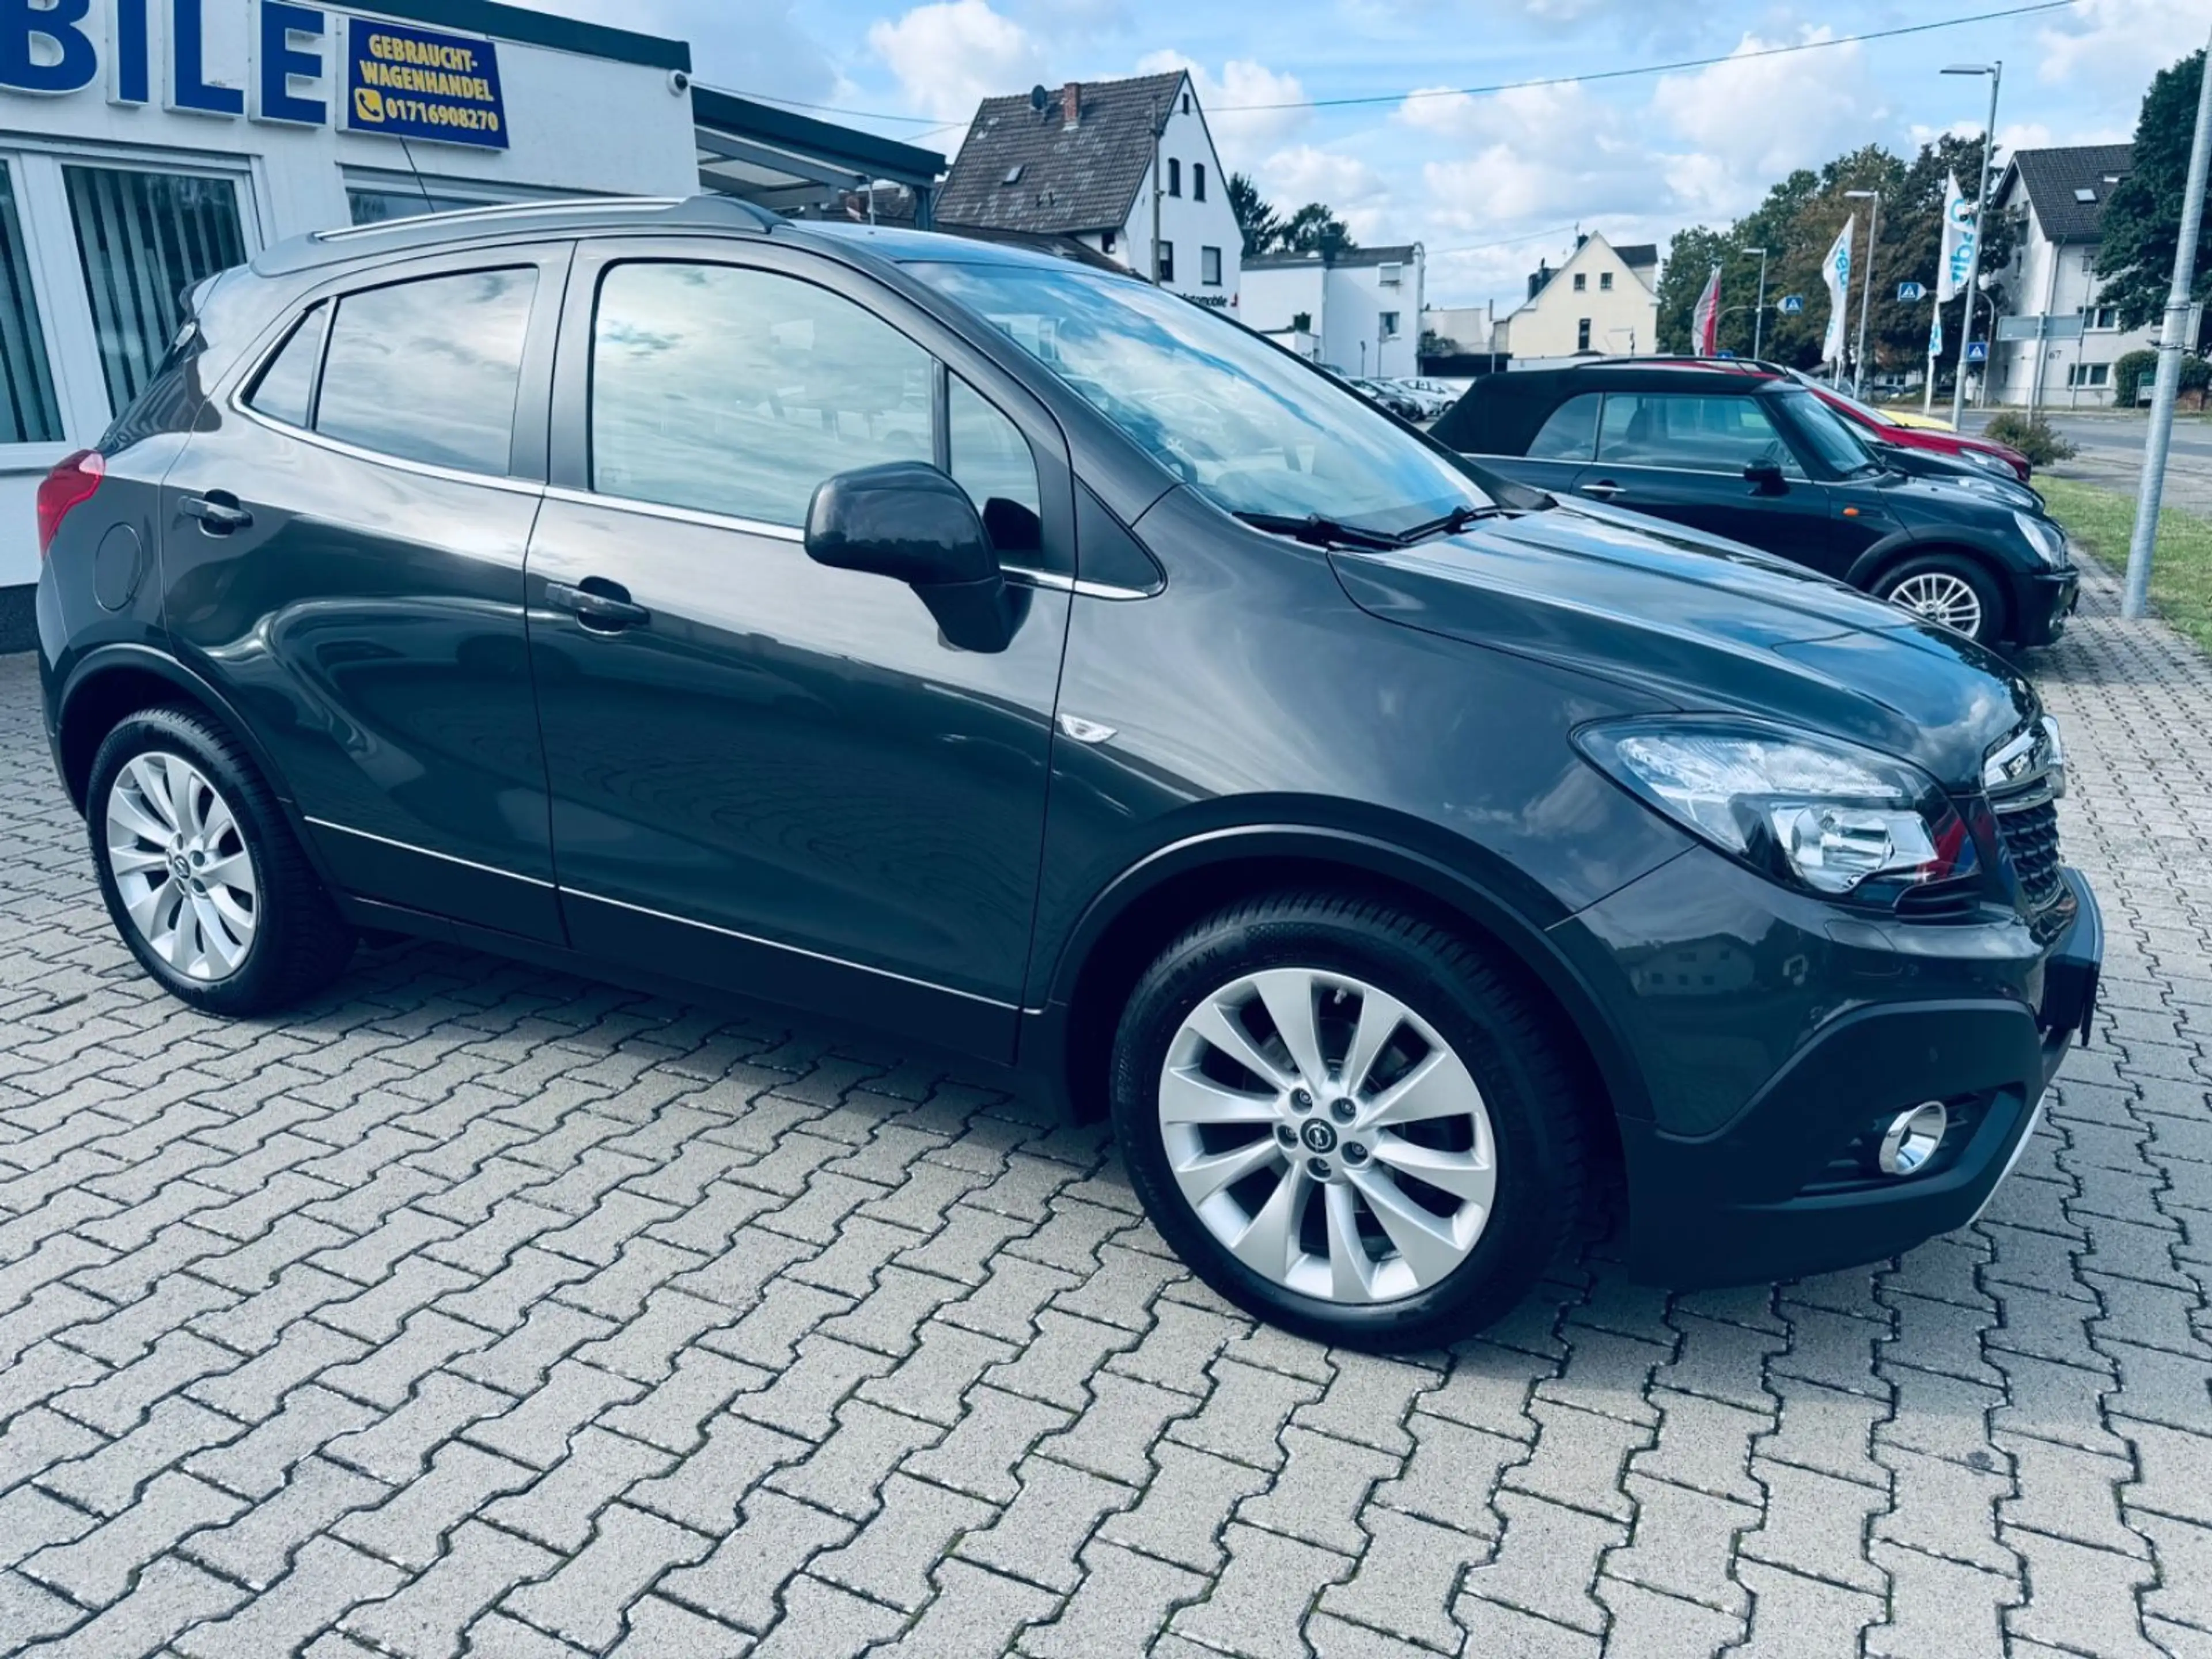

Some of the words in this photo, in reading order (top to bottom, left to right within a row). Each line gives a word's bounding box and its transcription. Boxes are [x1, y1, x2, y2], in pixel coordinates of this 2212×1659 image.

[0, 0, 327, 125] BILE
[369, 33, 478, 72] GEBRAUCHT-
[359, 59, 495, 102] WAGENHANDEL
[385, 97, 499, 132] 01716908270
